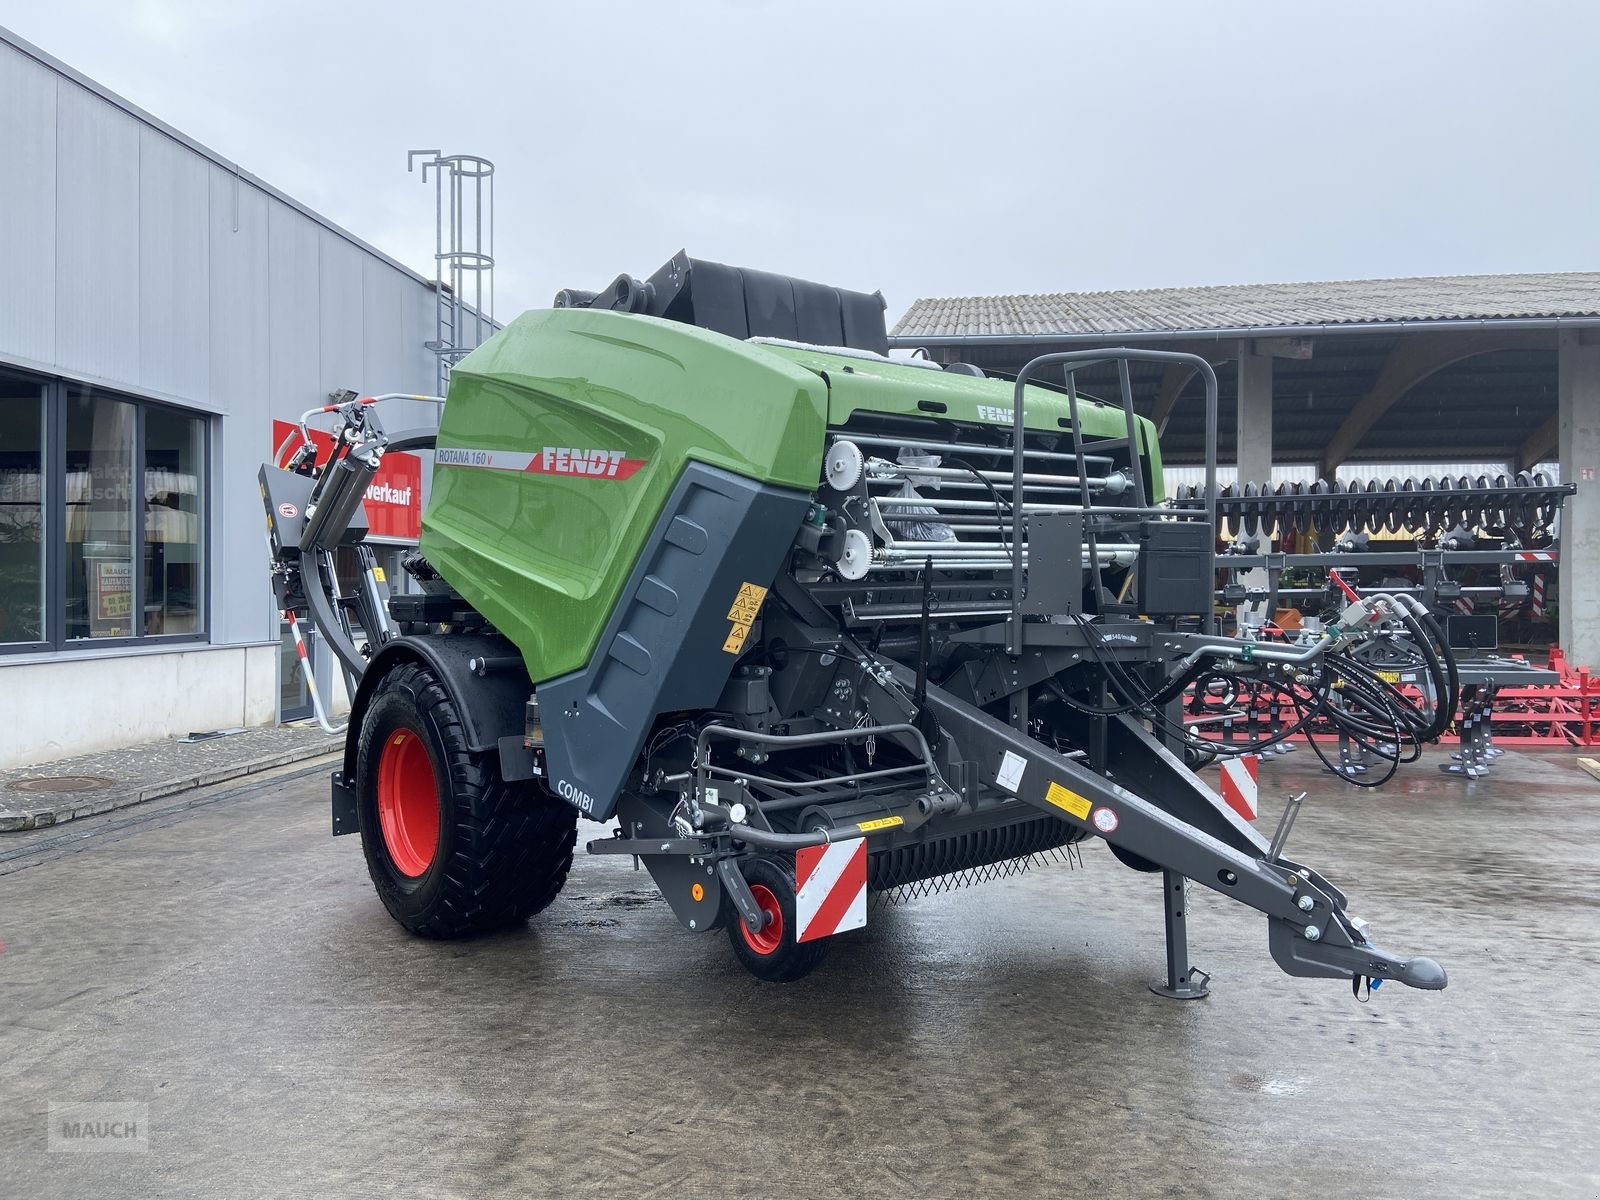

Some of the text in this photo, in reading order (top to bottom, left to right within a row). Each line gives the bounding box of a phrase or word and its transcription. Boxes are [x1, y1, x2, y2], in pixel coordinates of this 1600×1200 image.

[976, 404, 1028, 423] FEND
[439, 450, 470, 464] ROTANA
[471, 452, 486, 465] 160
[542, 446, 626, 476] FENDT
[363, 482, 411, 506] verkauf
[557, 779, 594, 813] COMBI
